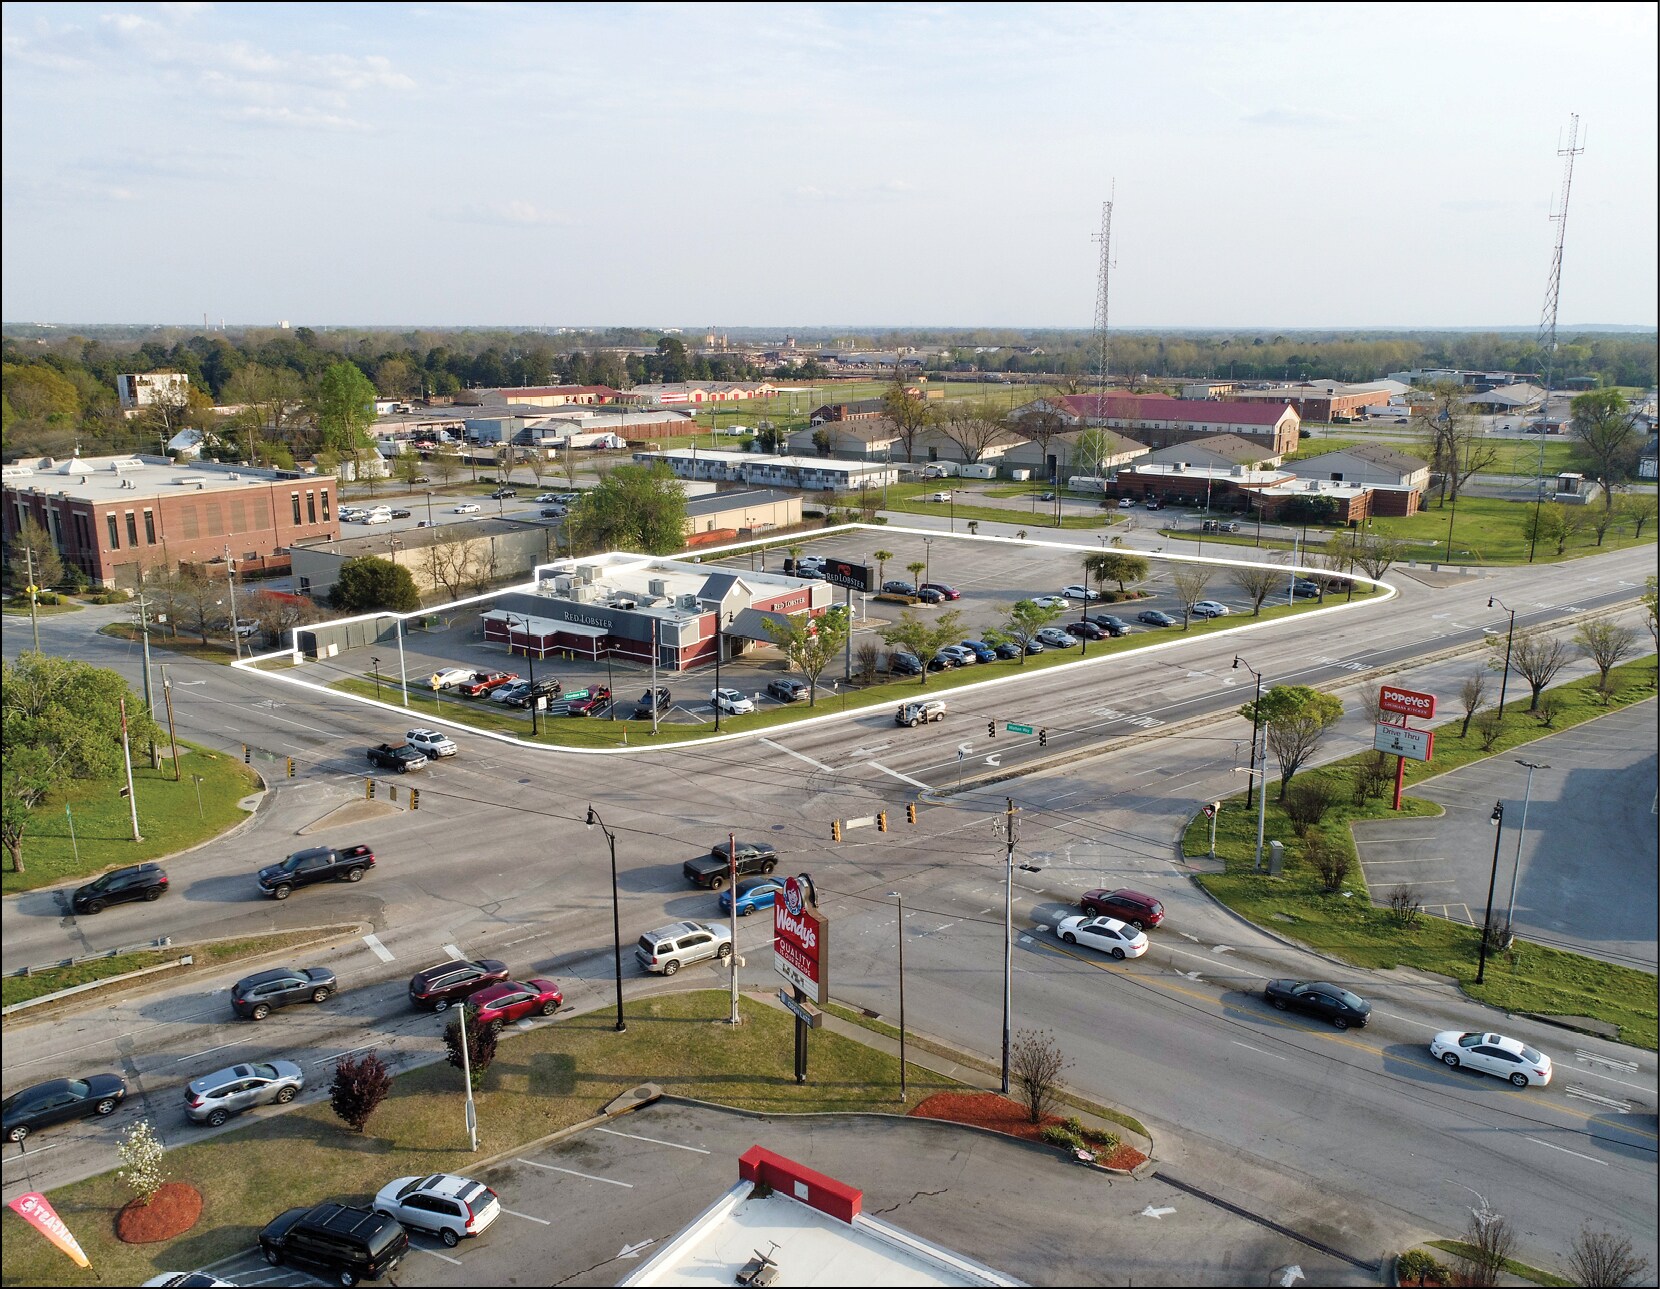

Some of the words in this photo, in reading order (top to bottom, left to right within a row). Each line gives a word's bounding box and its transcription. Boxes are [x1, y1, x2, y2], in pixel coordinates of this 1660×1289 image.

[566, 395, 593, 404] FAIR
[825, 572, 838, 582] RED
[839, 574, 864, 588] LOBSTER
[785, 598, 805, 607] LOBSTER
[564, 611, 580, 622] RED
[581, 614, 613, 628] LOBSTER
[1383, 727, 1400, 736] Drive
[1404, 732, 1419, 740] Thru
[776, 904, 816, 949] Wendy's
[780, 939, 811, 969] QUALITY
